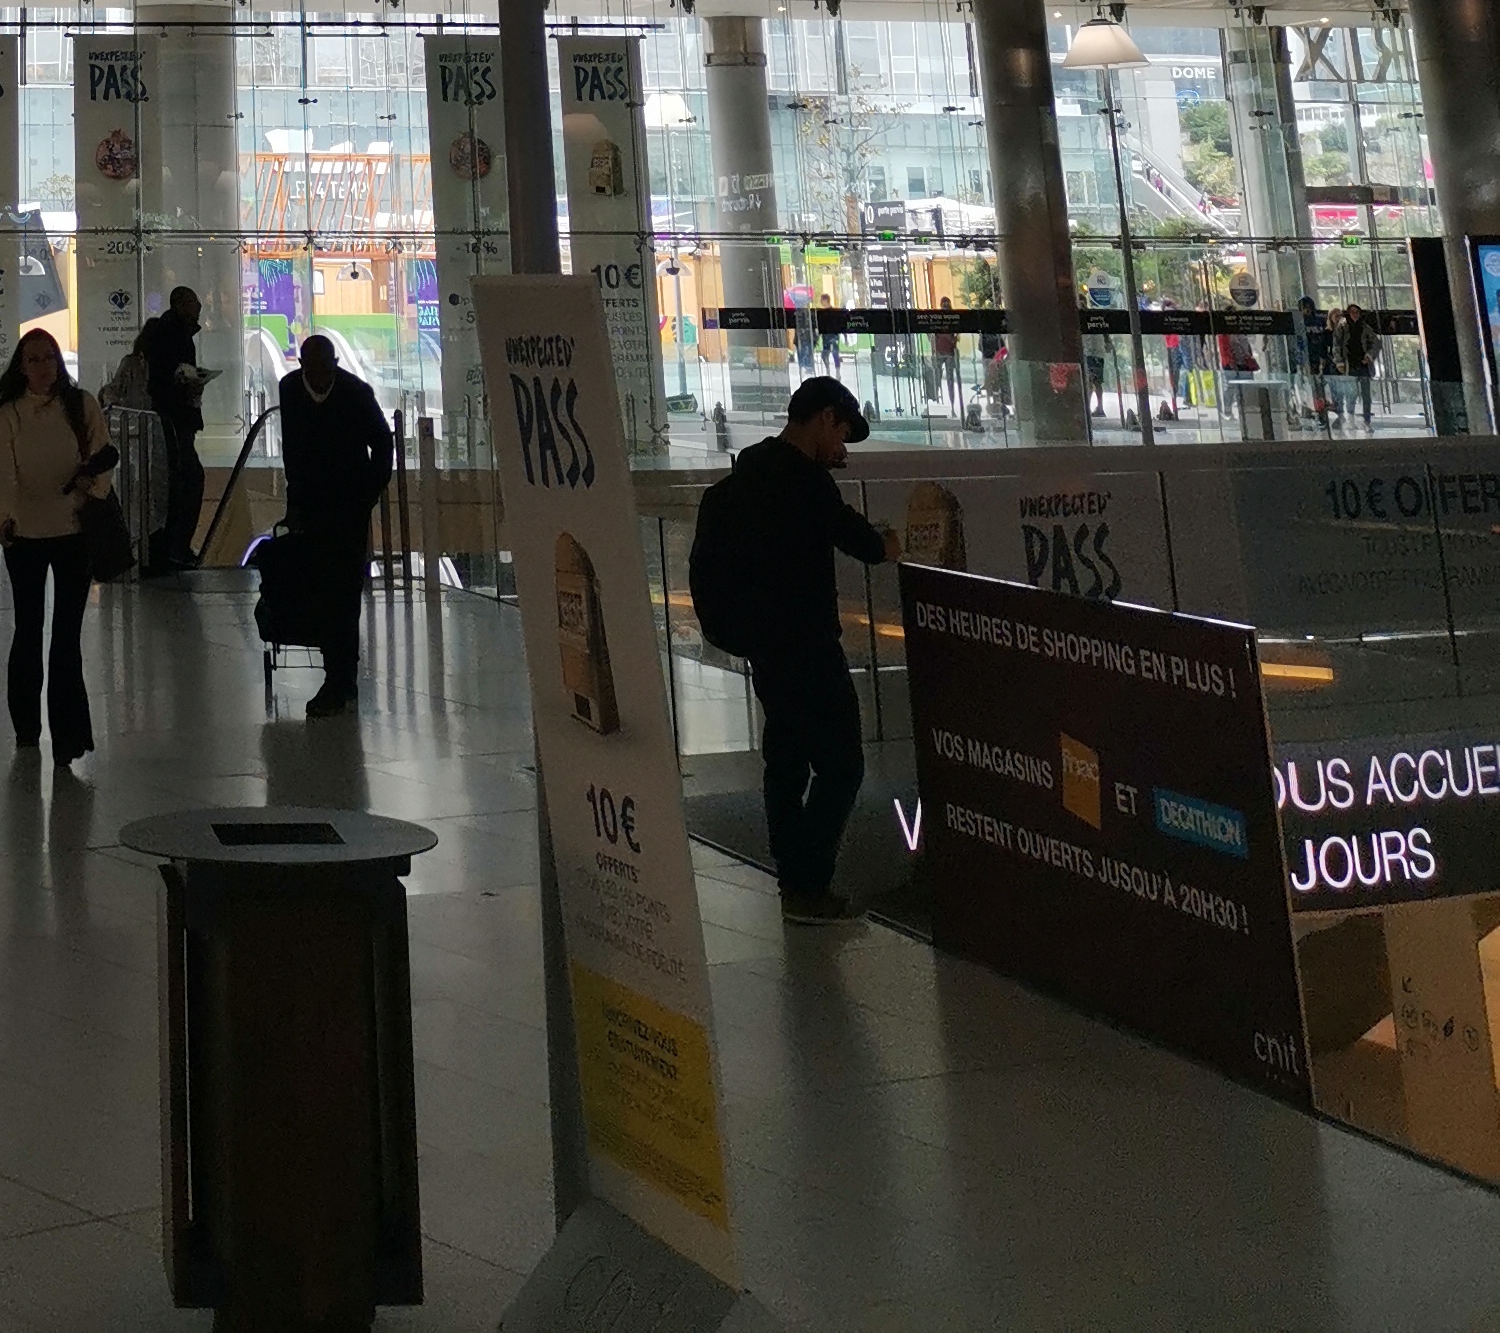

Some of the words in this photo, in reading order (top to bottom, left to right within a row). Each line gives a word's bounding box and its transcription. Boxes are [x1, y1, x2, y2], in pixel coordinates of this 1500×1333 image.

[89, 64, 147, 102] PASS
[439, 65, 497, 103] PASS
[573, 65, 629, 102] PASS
[1171, 66, 1217, 80] DOME
[509, 372, 596, 491] PASS
[1021, 522, 1122, 601] PASS
[915, 601, 946, 632] DES
[949, 608, 1015, 649] HEURES
[1015, 623, 1041, 654] DE
[1043, 628, 1136, 676] SHOPPING
[1139, 649, 1168, 682] EN
[1171, 654, 1226, 697] PLUS
[1228, 667, 1237, 699] !
[932, 728, 965, 763] VOS
[968, 737, 1054, 790] MAGASINS
[1113, 782, 1139, 816] ET
[1159, 797, 1242, 846] DECATHLON
[1273, 757, 1355, 812] US
[586, 782, 642, 855] 10€
[946, 803, 1016, 848] RESTENT
[1017, 826, 1095, 880] OUVERTS
[1098, 856, 1177, 911] JUSQU'À
[1179, 884, 1239, 932] 20H30
[1241, 903, 1250, 935] !
[1290, 827, 1437, 891] JOURS
[1253, 1031, 1300, 1076] cnit
